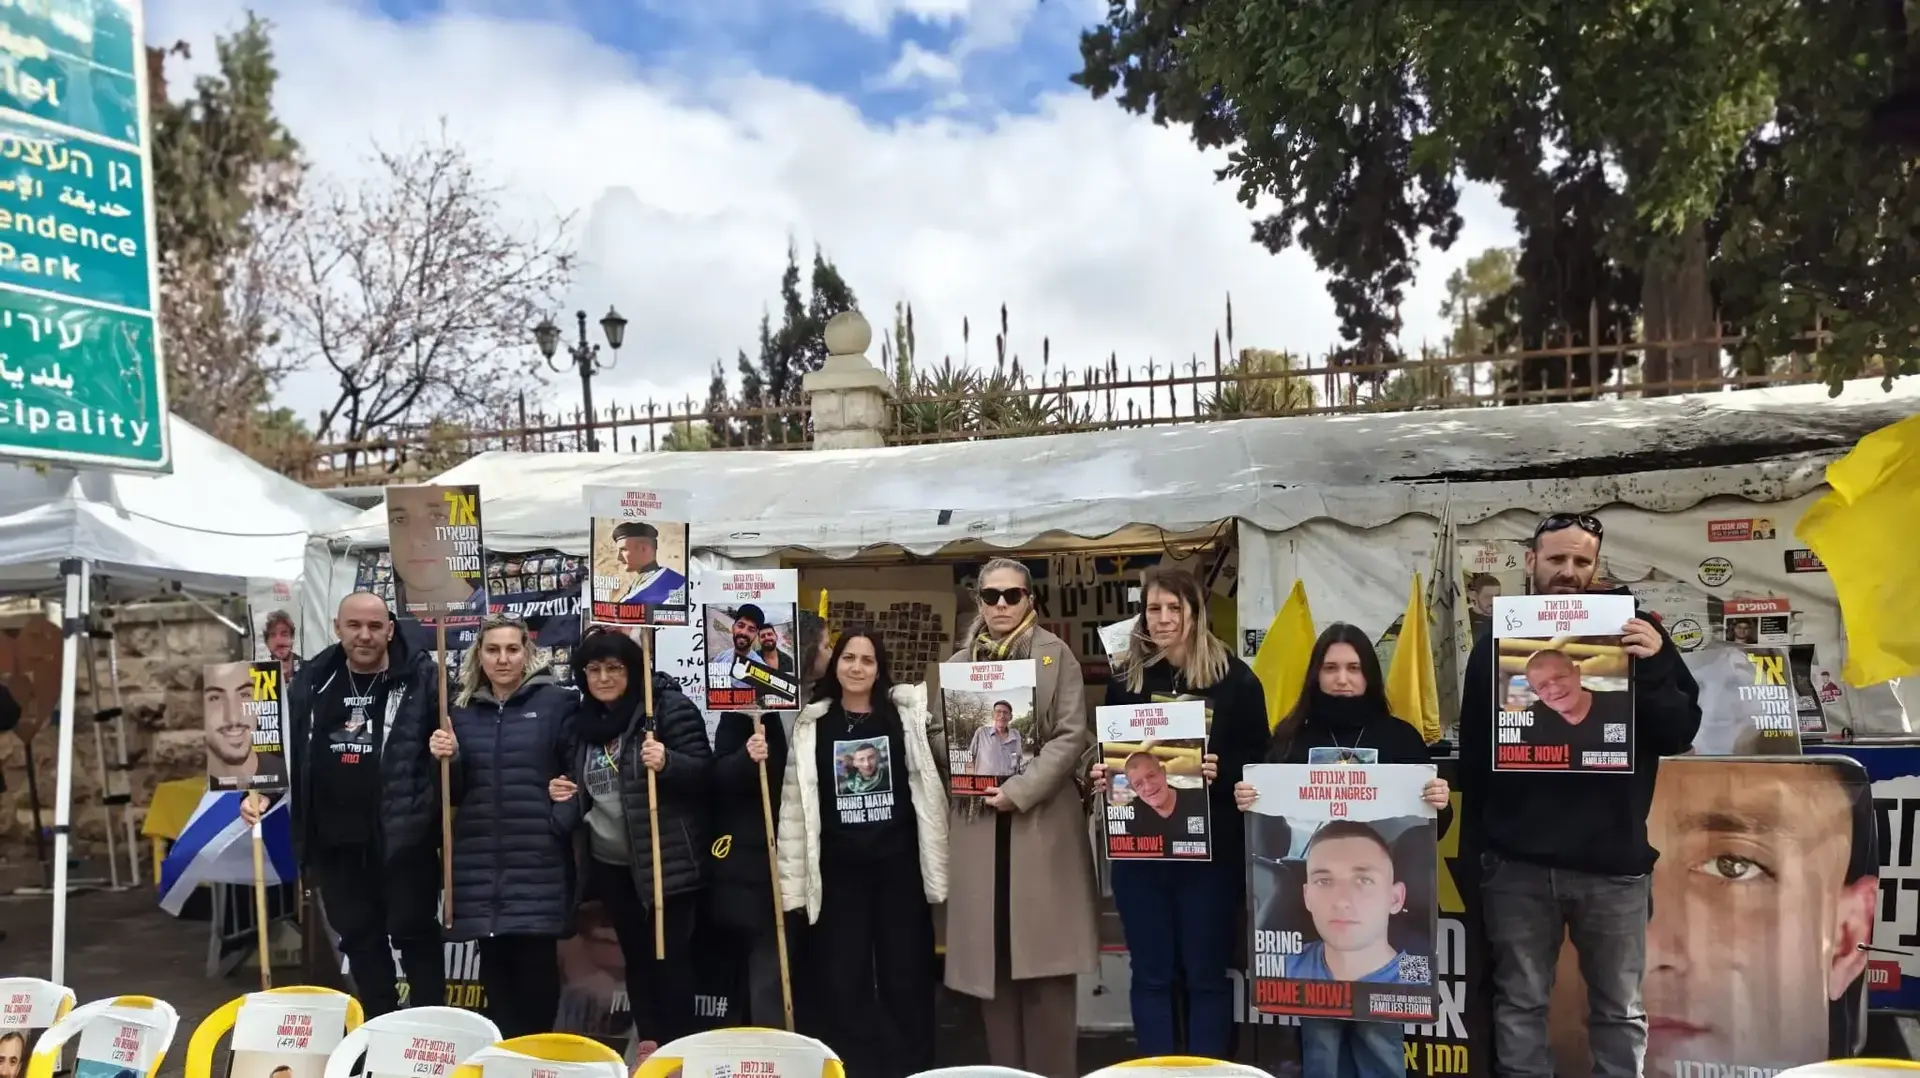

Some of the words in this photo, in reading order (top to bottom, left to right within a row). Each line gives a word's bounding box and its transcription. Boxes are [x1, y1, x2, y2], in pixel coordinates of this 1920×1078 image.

[0, 137, 93, 178] העצמ
[108, 160, 132, 192] גן
[58, 185, 132, 216] حديقة
[0, 208, 137, 257] endence
[0, 241, 81, 283] Park
[3, 310, 82, 350] עירי
[443, 491, 477, 525] אל
[435, 526, 479, 540] תשאירו
[454, 541, 479, 556] אותי
[445, 556, 480, 571] מאחור
[594, 576, 619, 589] BRING
[754, 582, 775, 590] BERMAN
[594, 603, 618, 616] HOME
[620, 604, 645, 618] NOW!
[1544, 600, 1569, 610] גודארד
[1572, 600, 1583, 609] מני
[1737, 602, 1777, 612] חטופים
[1538, 611, 1558, 620] MENY
[1560, 610, 1589, 620] GODARD
[1556, 621, 1571, 632] (73)
[1747, 653, 1787, 686] אל
[248, 668, 278, 700] אל
[709, 690, 733, 703] HOME
[1738, 686, 1789, 701] תשאירו
[242, 701, 278, 716] תשאירו
[1760, 700, 1790, 715] אותי
[257, 715, 279, 729] אותי
[1146, 717, 1169, 726] GODARD
[1498, 711, 1534, 727] BRING
[1751, 715, 1793, 730] מאחור
[250, 730, 280, 744] מאחור
[1144, 727, 1156, 736] (73)
[1498, 728, 1521, 744] HIM
[348, 743, 361, 753] שלי
[1499, 746, 1532, 762] HOME
[1534, 744, 1569, 762] NOW!
[949, 750, 973, 762] BRING
[951, 763, 966, 775] HIM
[952, 776, 973, 789] HOME
[1310, 770, 1346, 784] אנגרסט
[1348, 770, 1367, 785] מתן
[1299, 786, 1332, 800] MATAN
[1334, 786, 1378, 800] ANGREST
[836, 797, 863, 810] BRING
[864, 793, 894, 808] MATAN
[1330, 801, 1347, 817] (21)
[841, 810, 866, 823] HOME
[868, 807, 892, 821] NOW!
[1107, 806, 1135, 820] BRING
[1108, 821, 1127, 835] HIM
[1109, 836, 1136, 851] HOME
[1137, 835, 1163, 851] NOW!
[1255, 929, 1302, 954] BRING
[1255, 954, 1285, 978] HIM
[1256, 981, 1300, 1005] HOME
[1305, 982, 1353, 1008] NOW!
[1370, 1001, 1403, 1014] FAMILIES
[1404, 1003, 1432, 1016] FORUM
[277, 1025, 293, 1036] OMRI
[294, 1026, 313, 1037] MIRAN
[404, 1048, 418, 1060] GUY
[418, 1050, 457, 1066] GILBOA-DALAL
[1427, 1043, 1468, 1077] מתן
[413, 1062, 432, 1074] (23)
[760, 1061, 775, 1074] שגב
